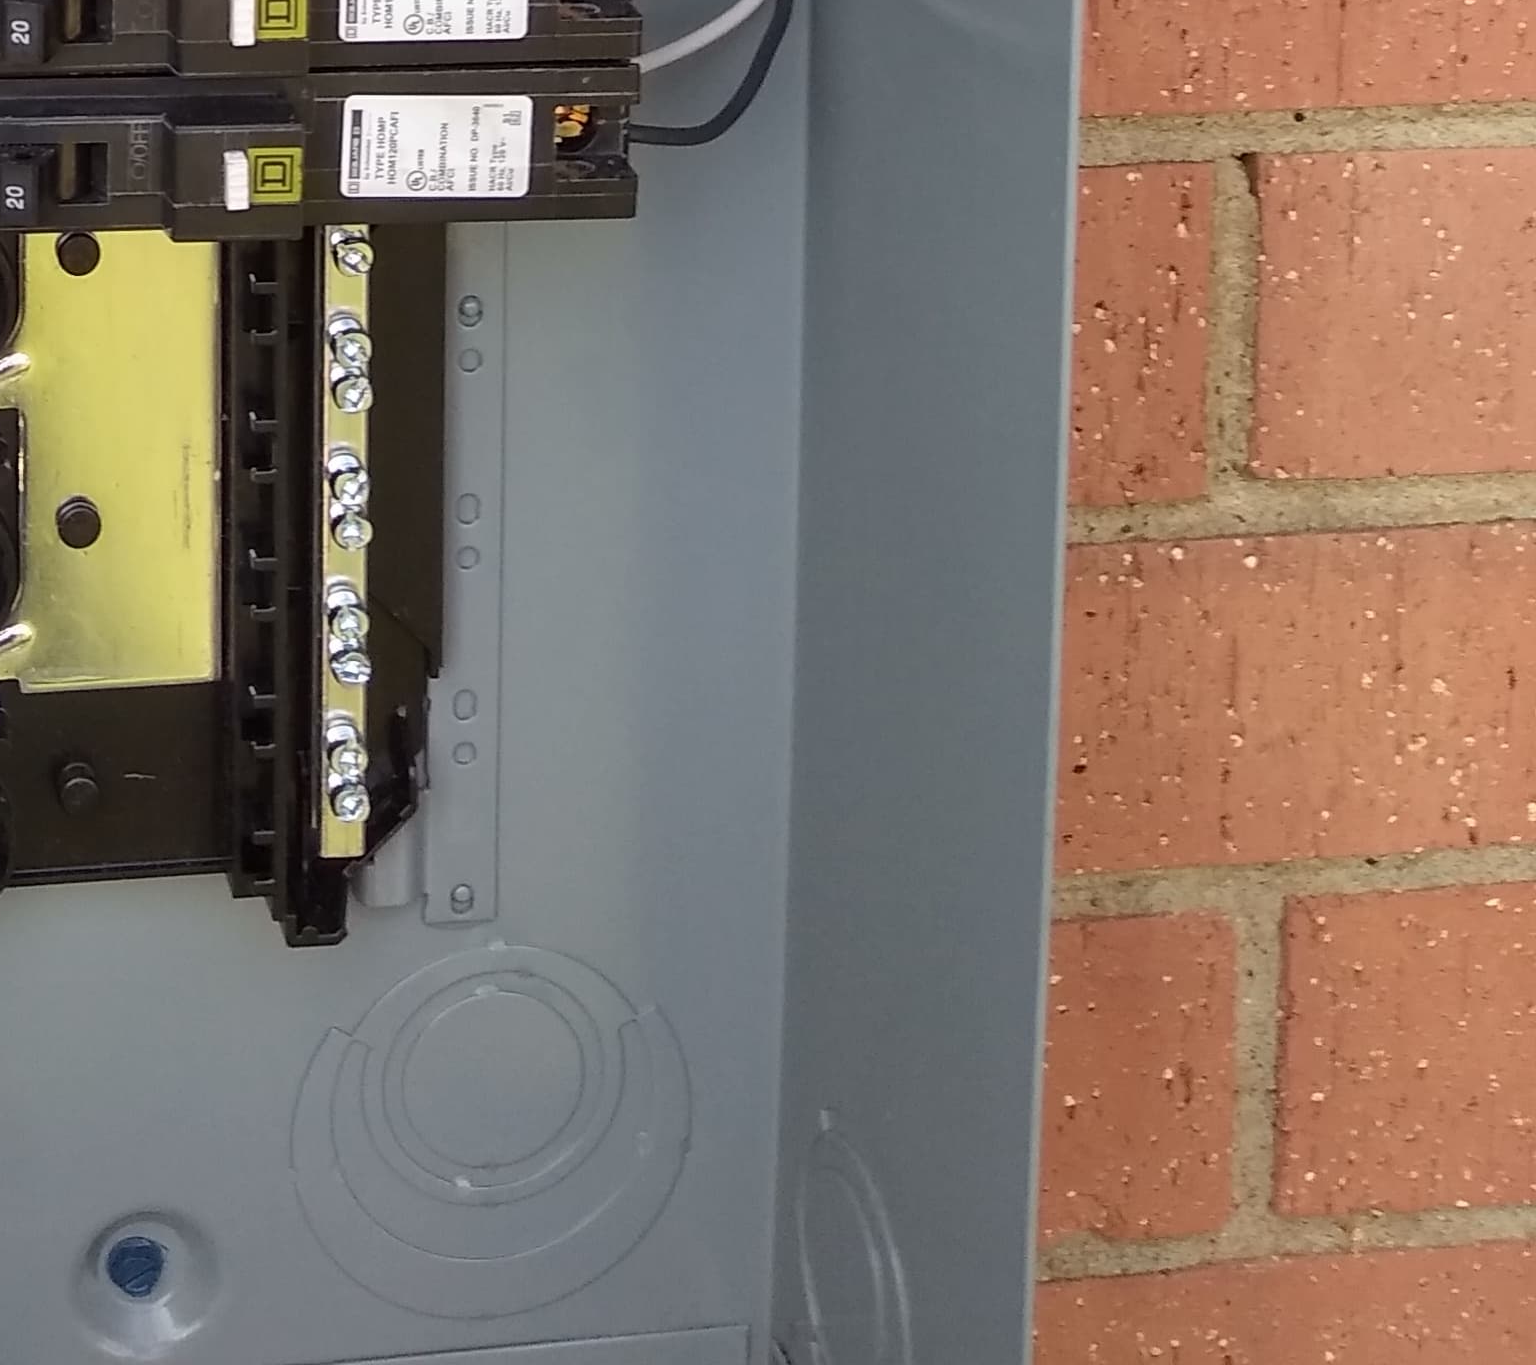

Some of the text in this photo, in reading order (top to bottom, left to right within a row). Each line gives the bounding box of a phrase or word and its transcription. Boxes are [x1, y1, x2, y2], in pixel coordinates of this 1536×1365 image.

[11, 20, 31, 45] 20
[375, 117, 386, 179] TYPE HOMP
[437, 122, 449, 191] COMBINATION
[5, 185, 25, 210] 20
